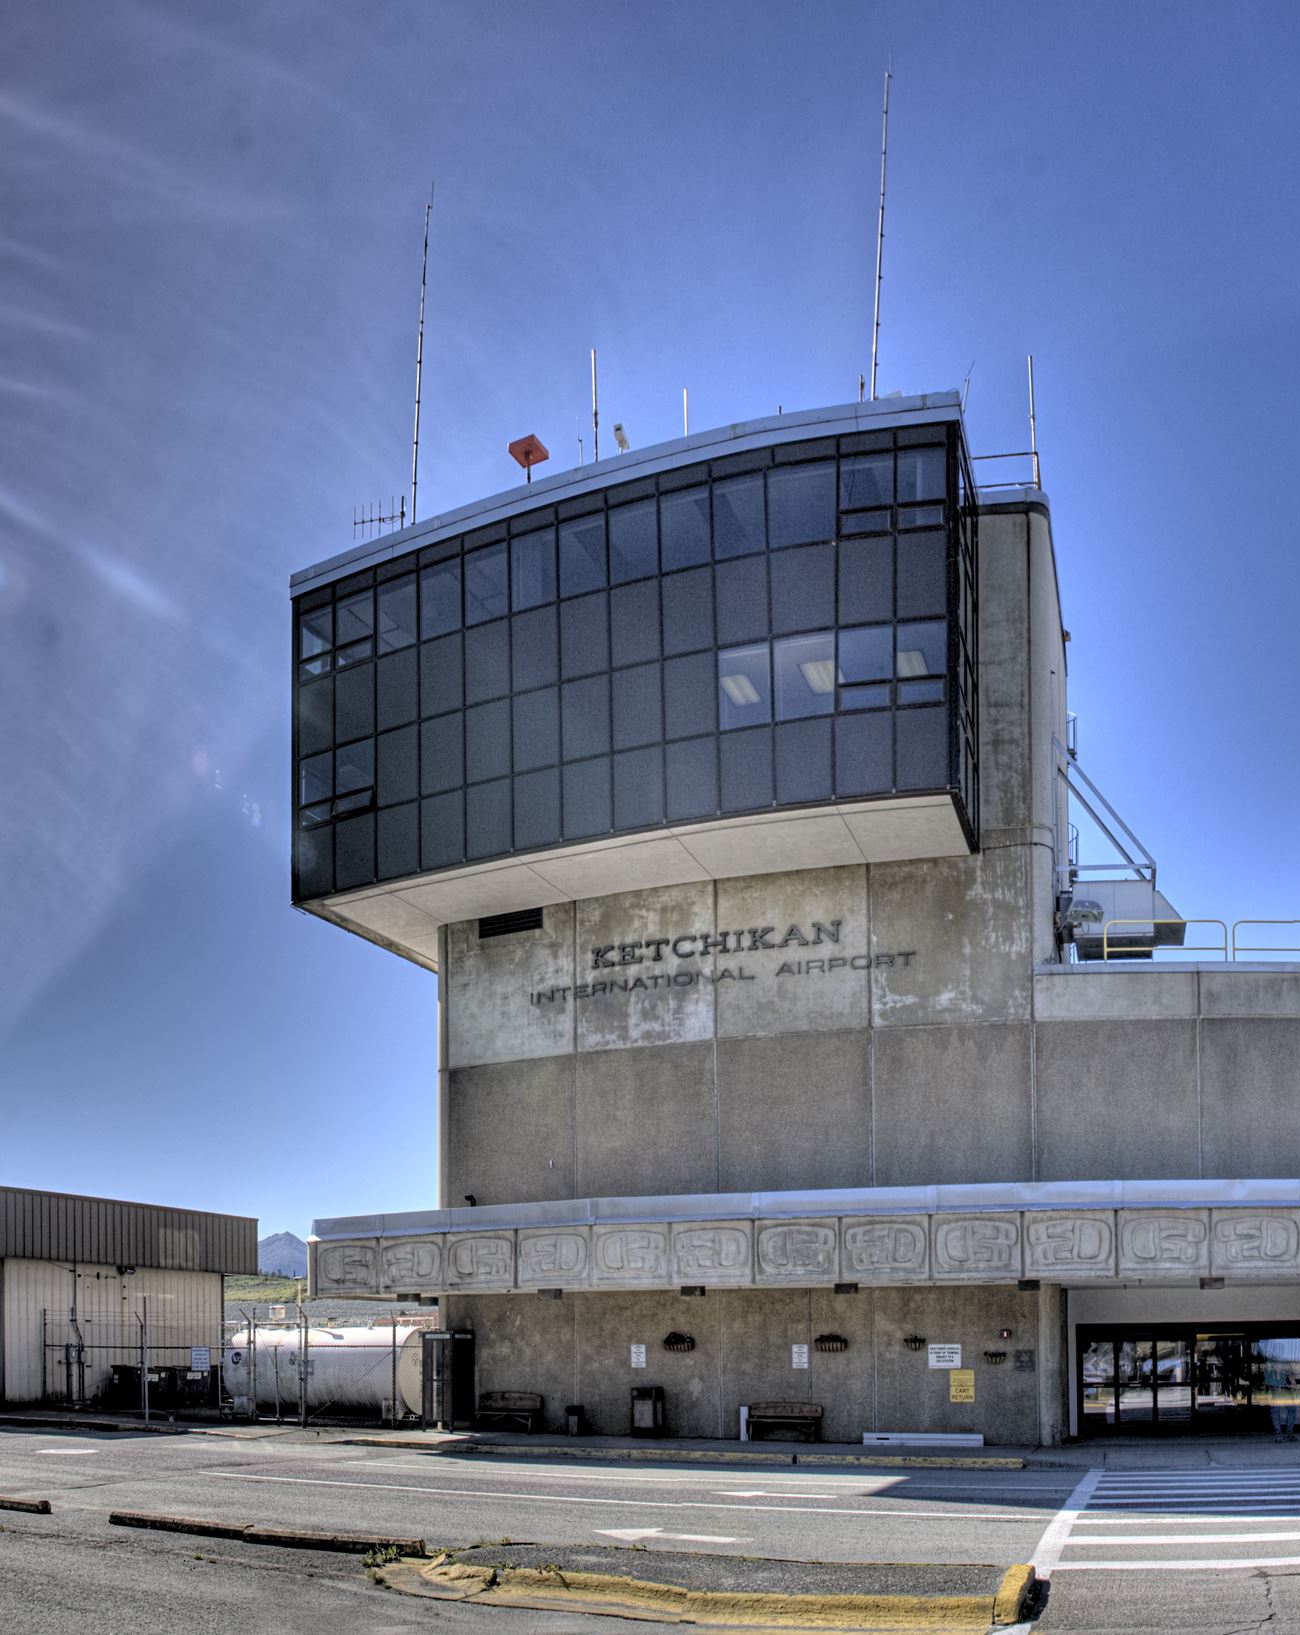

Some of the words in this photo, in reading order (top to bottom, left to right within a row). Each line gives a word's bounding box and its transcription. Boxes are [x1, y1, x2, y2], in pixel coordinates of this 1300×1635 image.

[590, 919, 843, 970] KETCHIKAN
[530, 965, 756, 1006] INTERNATIONAL
[775, 950, 917, 977] AIRPORT
